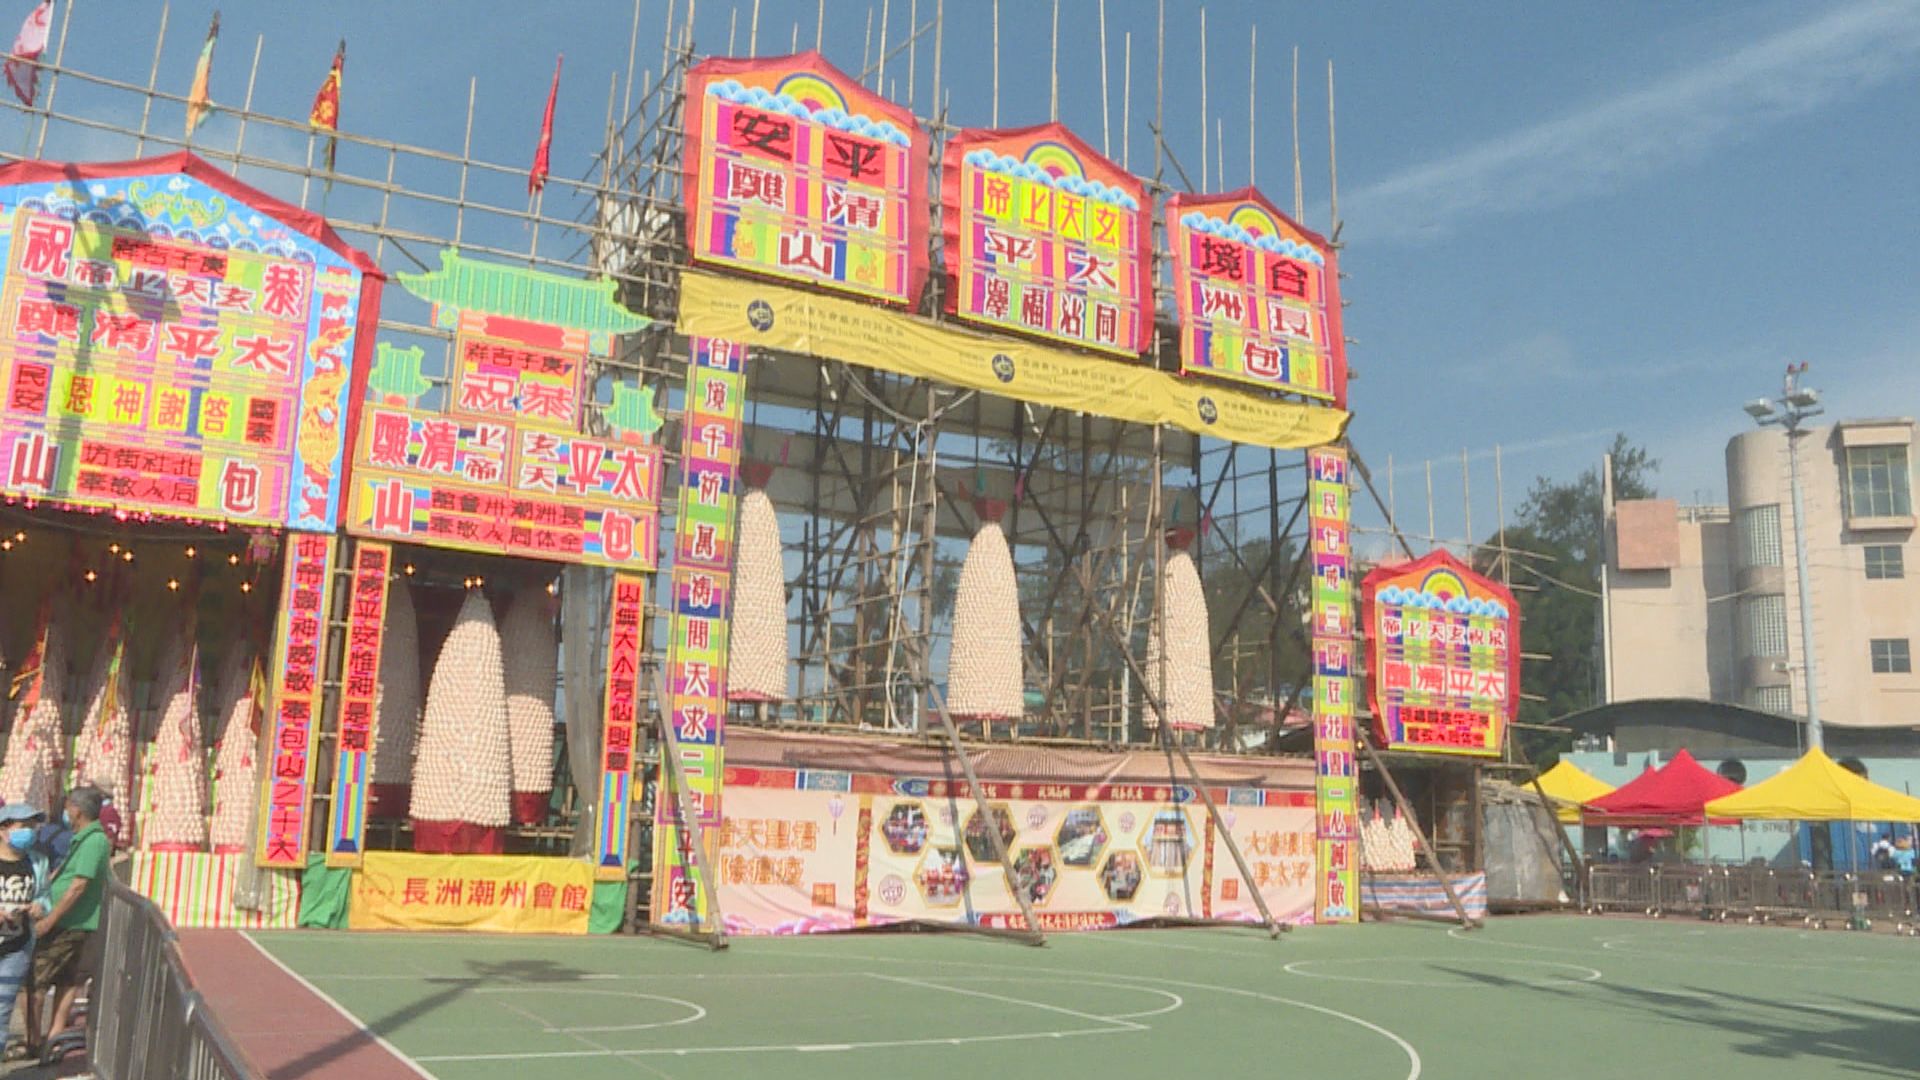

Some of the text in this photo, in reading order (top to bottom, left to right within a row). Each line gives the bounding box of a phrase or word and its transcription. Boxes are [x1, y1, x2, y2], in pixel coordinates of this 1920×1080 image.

[733, 110, 880, 178] 平安
[987, 177, 1118, 246] 玄天上帝
[22, 220, 74, 278] 祝
[778, 232, 835, 278] 山
[986, 228, 1118, 291] 太平
[1243, 339, 1282, 378] 包
[66, 376, 229, 433] 答謝神恩
[8, 432, 261, 514] 包 山
[372, 479, 636, 561] 包 山
[402, 876, 589, 913] 長洲潮州會館
